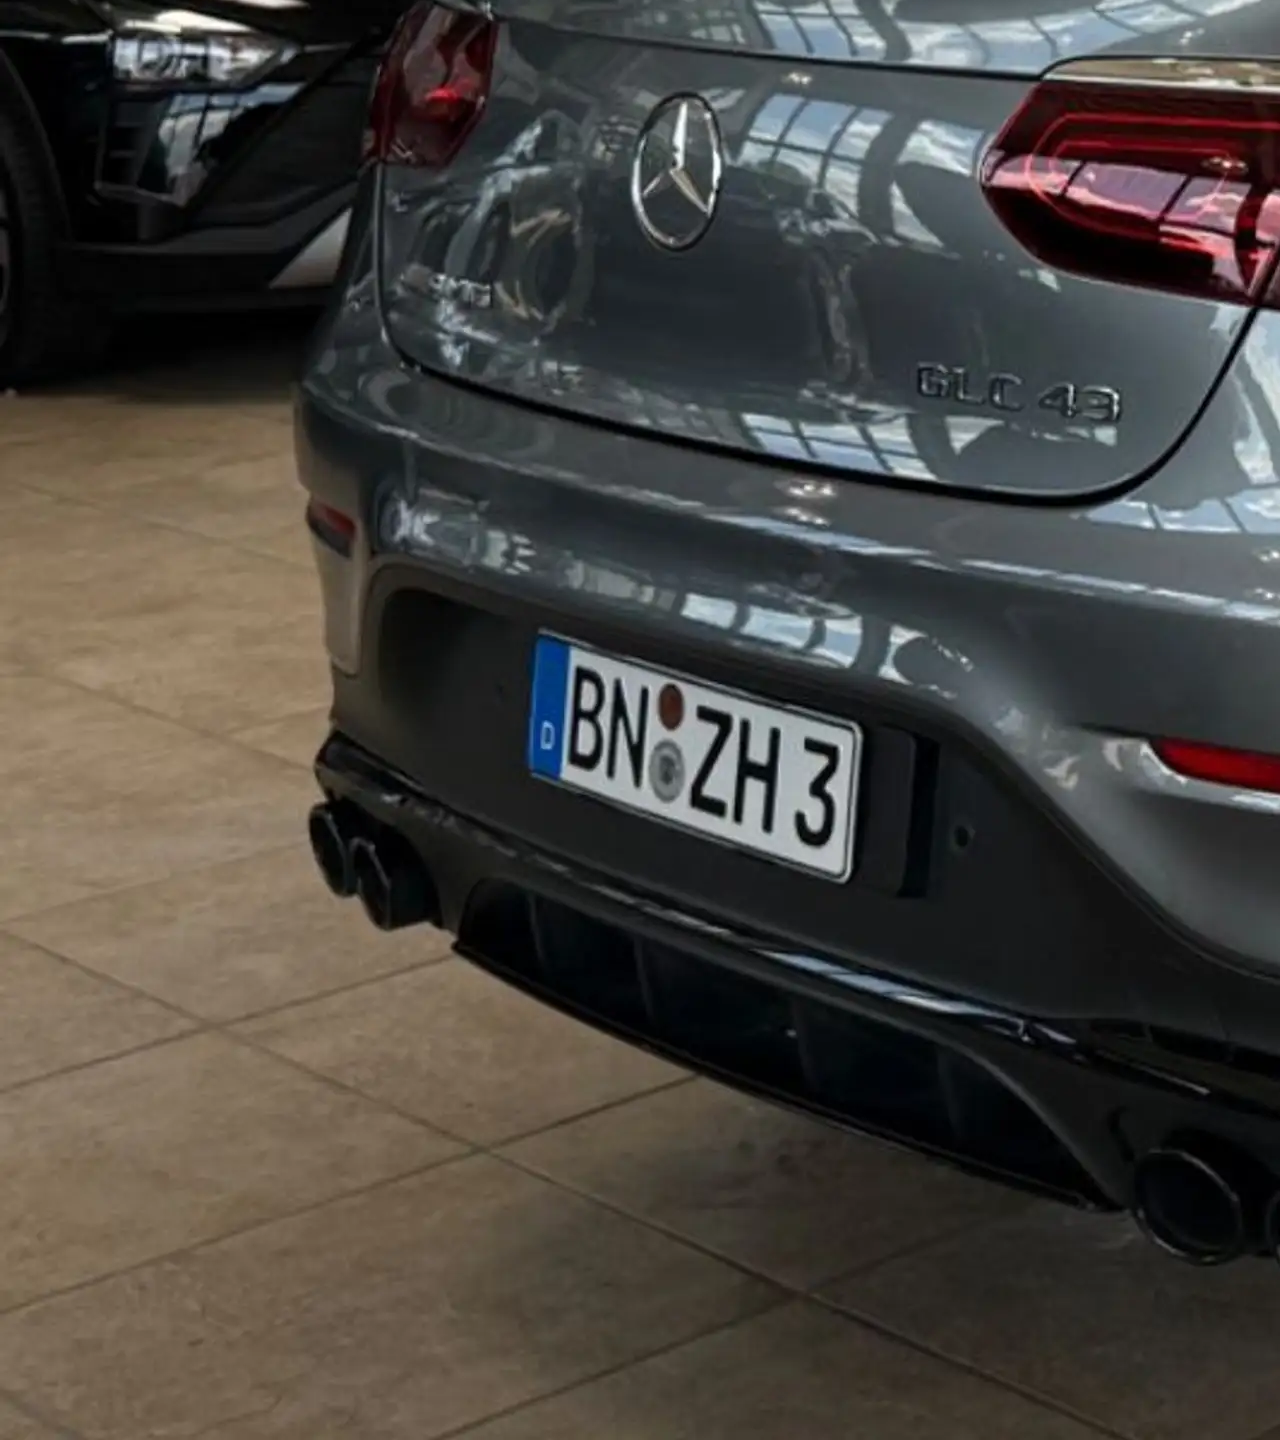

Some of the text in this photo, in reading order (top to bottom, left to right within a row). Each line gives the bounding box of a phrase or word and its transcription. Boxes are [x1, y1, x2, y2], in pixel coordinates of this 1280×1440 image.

[916, 361, 1122, 424] GLC 43
[567, 665, 650, 789] BN
